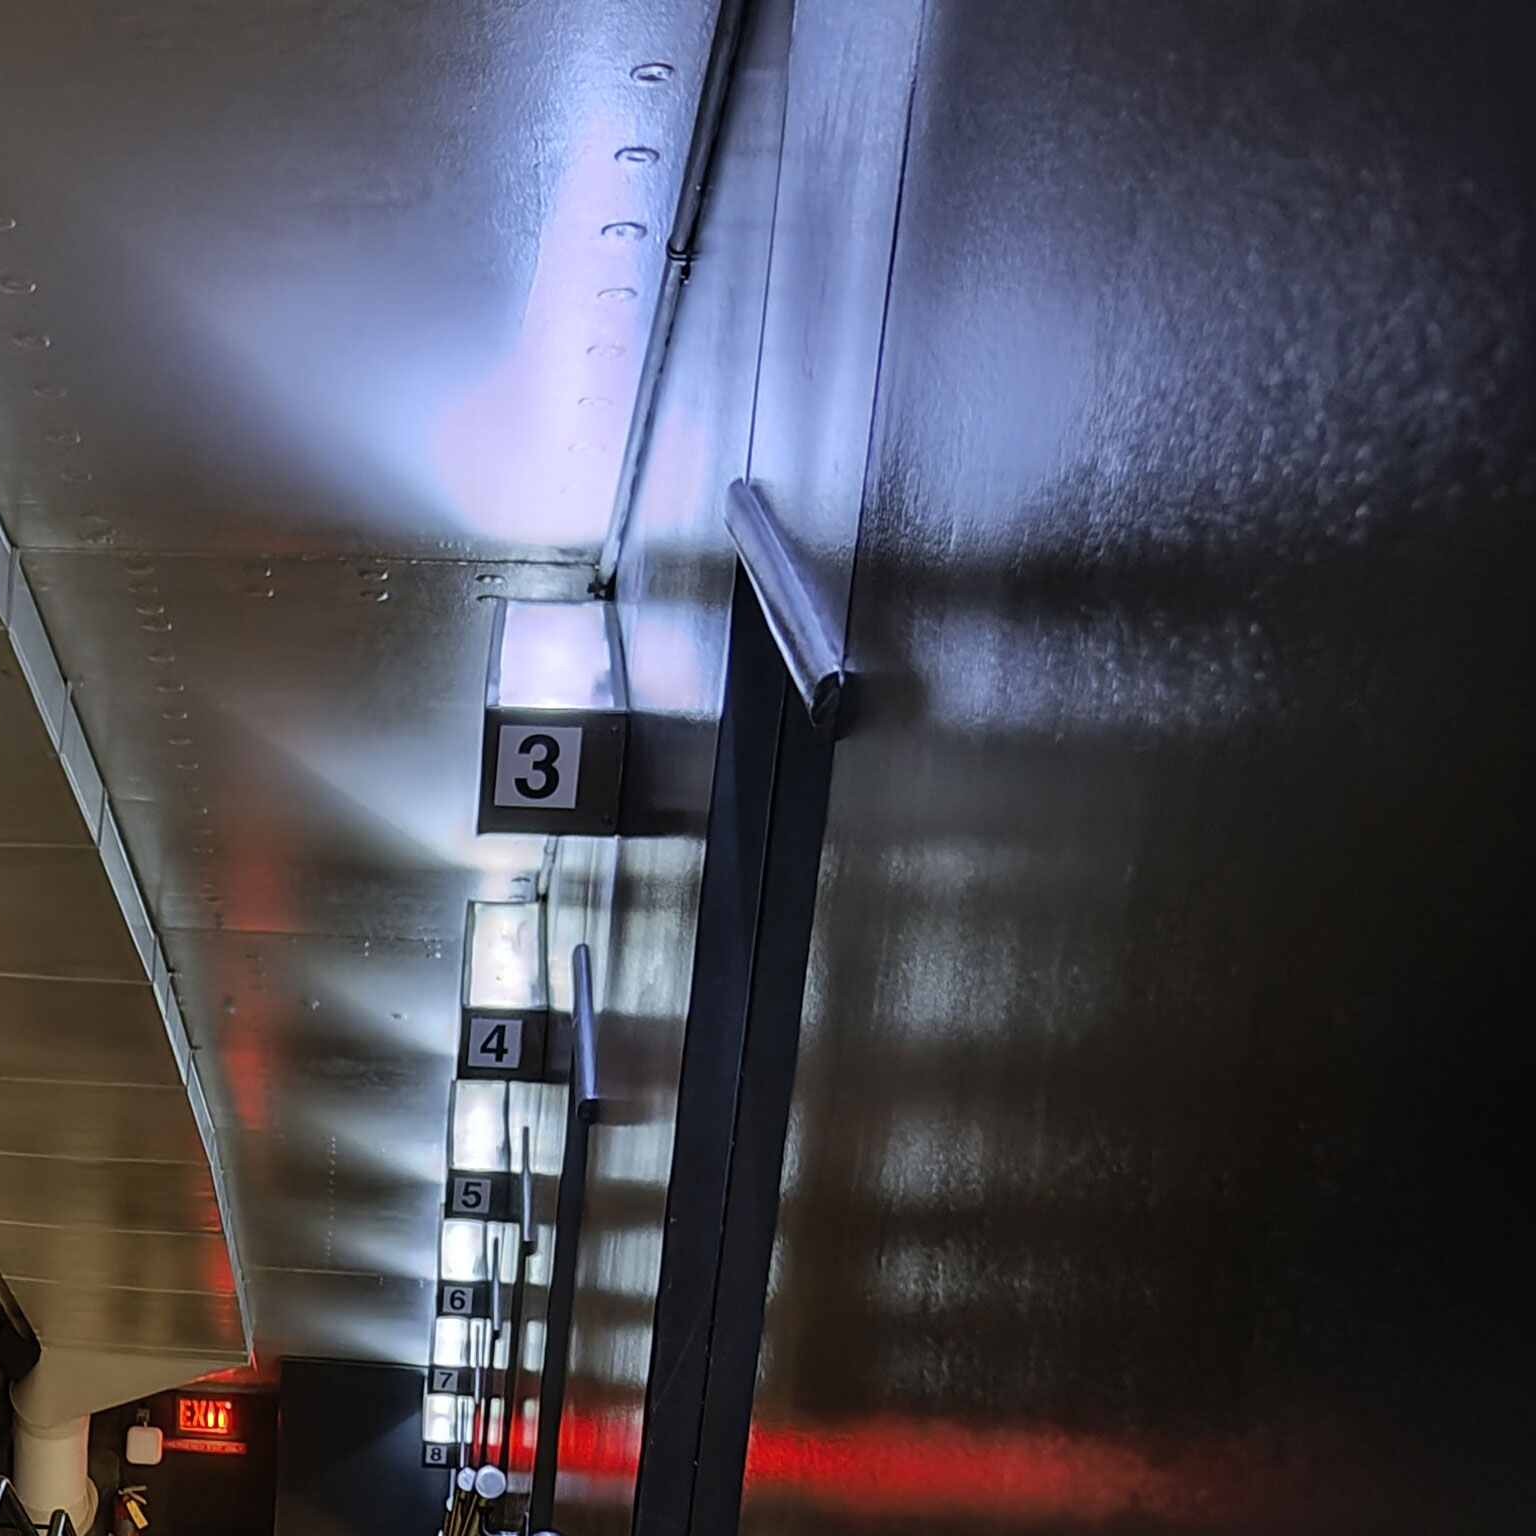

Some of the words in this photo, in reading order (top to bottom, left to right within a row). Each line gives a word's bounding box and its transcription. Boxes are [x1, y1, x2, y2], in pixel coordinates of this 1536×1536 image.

[514, 734, 560, 799] 3
[480, 1025, 508, 1063] 4
[461, 1182, 482, 1209] 5
[450, 1290, 466, 1311] 6
[439, 1371, 454, 1390] 7
[180, 1399, 231, 1428] EXIT
[430, 1448, 442, 1462] 8
